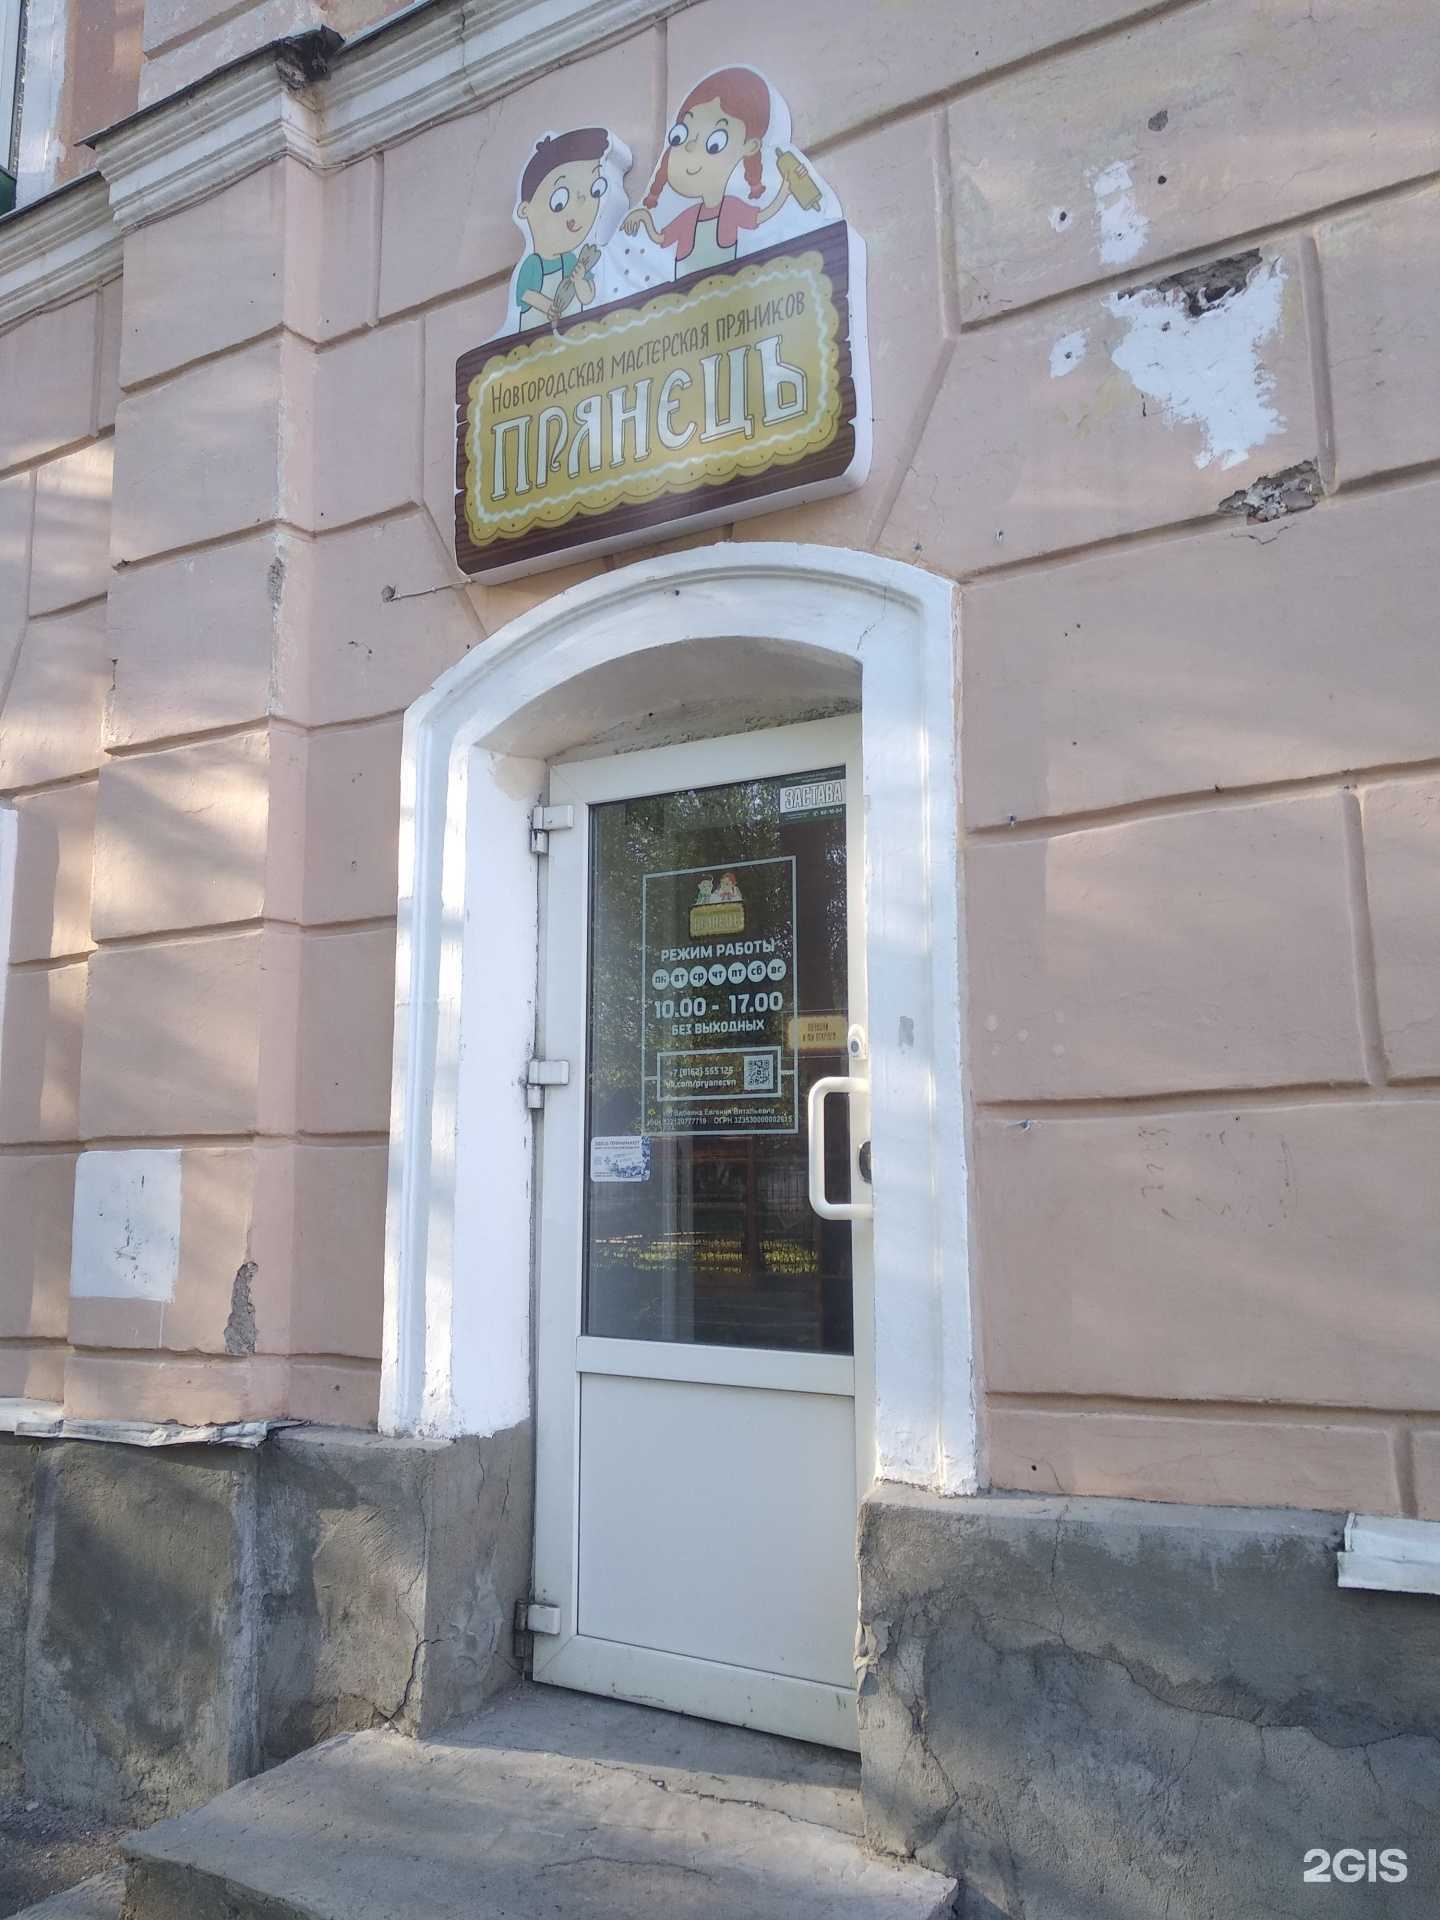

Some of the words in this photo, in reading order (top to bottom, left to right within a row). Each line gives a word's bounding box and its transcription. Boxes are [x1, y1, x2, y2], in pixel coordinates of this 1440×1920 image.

[491, 356, 605, 414] НОВГОРОДСКАЯ
[611, 322, 710, 379] МАСТЕРСКАЯ
[716, 291, 805, 343] ПРЯНИКОВ
[785, 782, 842, 809] ЗАСТАВА
[661, 945, 713, 961] РЕЖИМ
[716, 939, 775, 956] РАБОТЫ
[655, 997, 707, 1019] 10.00
[729, 991, 783, 1014] 17.00
[672, 1023, 692, 1036] БЕЗ
[695, 1019, 765, 1035] ВЫХОДНЫХ
